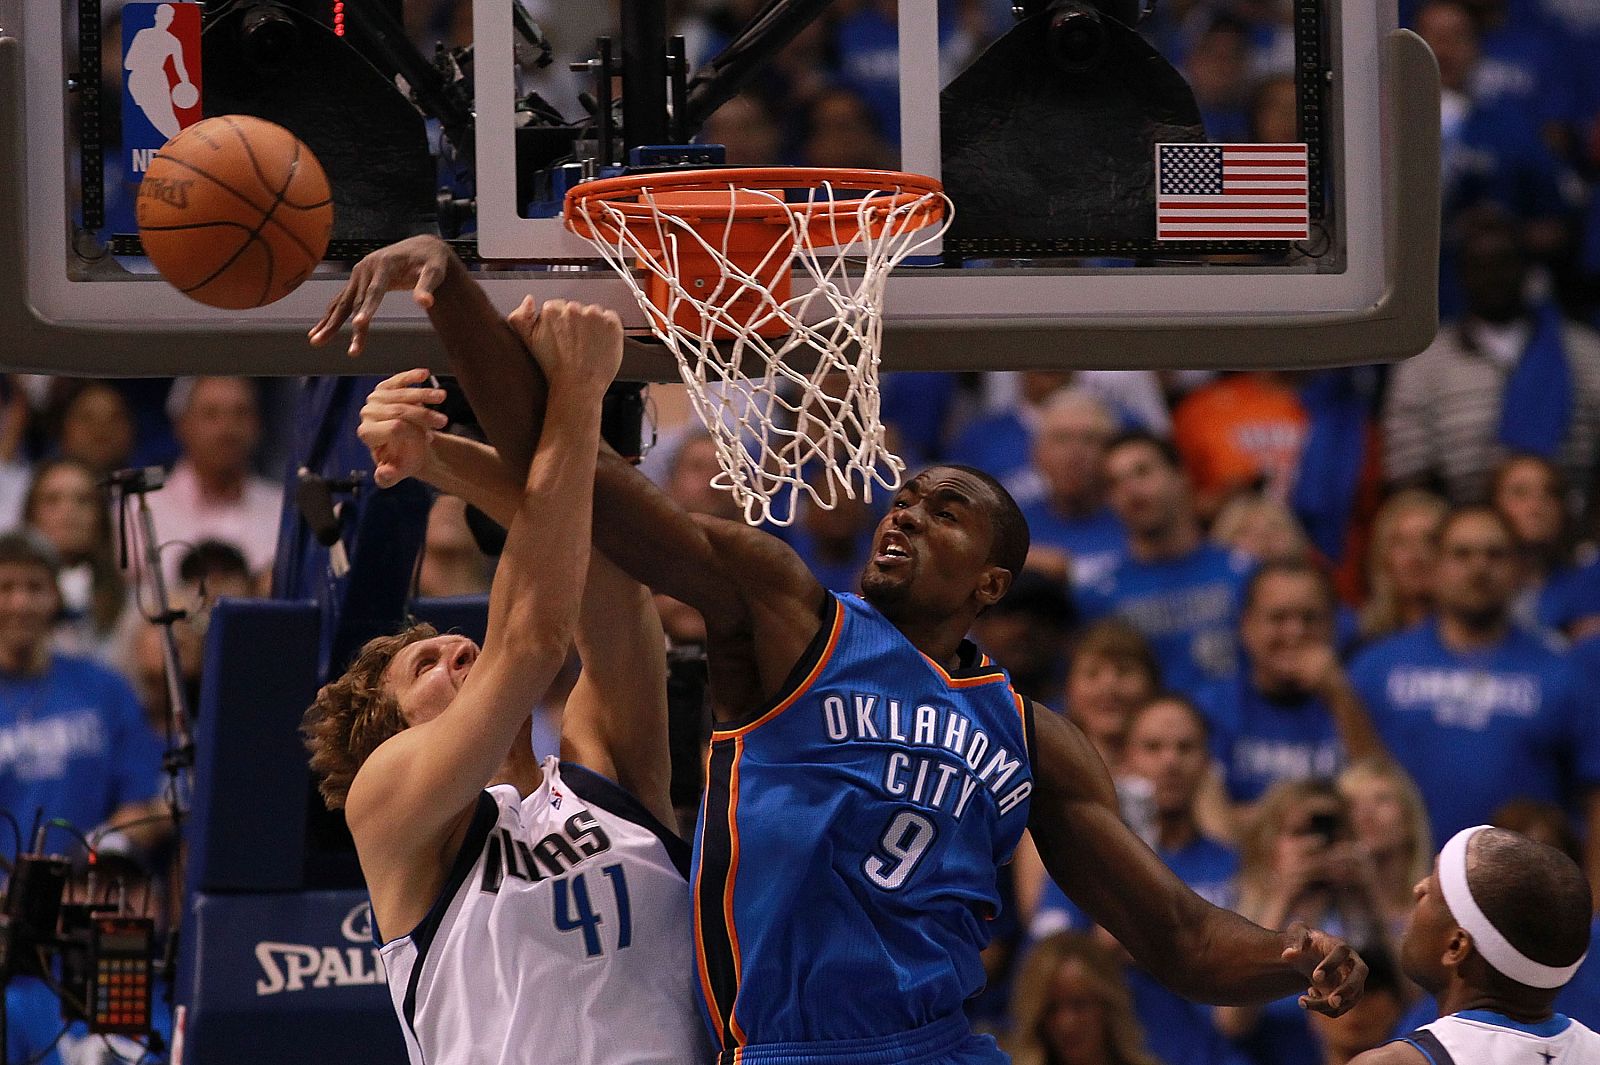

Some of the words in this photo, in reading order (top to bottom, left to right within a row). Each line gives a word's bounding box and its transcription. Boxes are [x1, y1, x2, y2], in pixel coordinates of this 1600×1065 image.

[824, 696, 1033, 816] OKLAHOMA
[886, 752, 976, 818] CITY
[864, 811, 935, 889] 9
[553, 863, 633, 957] 41
